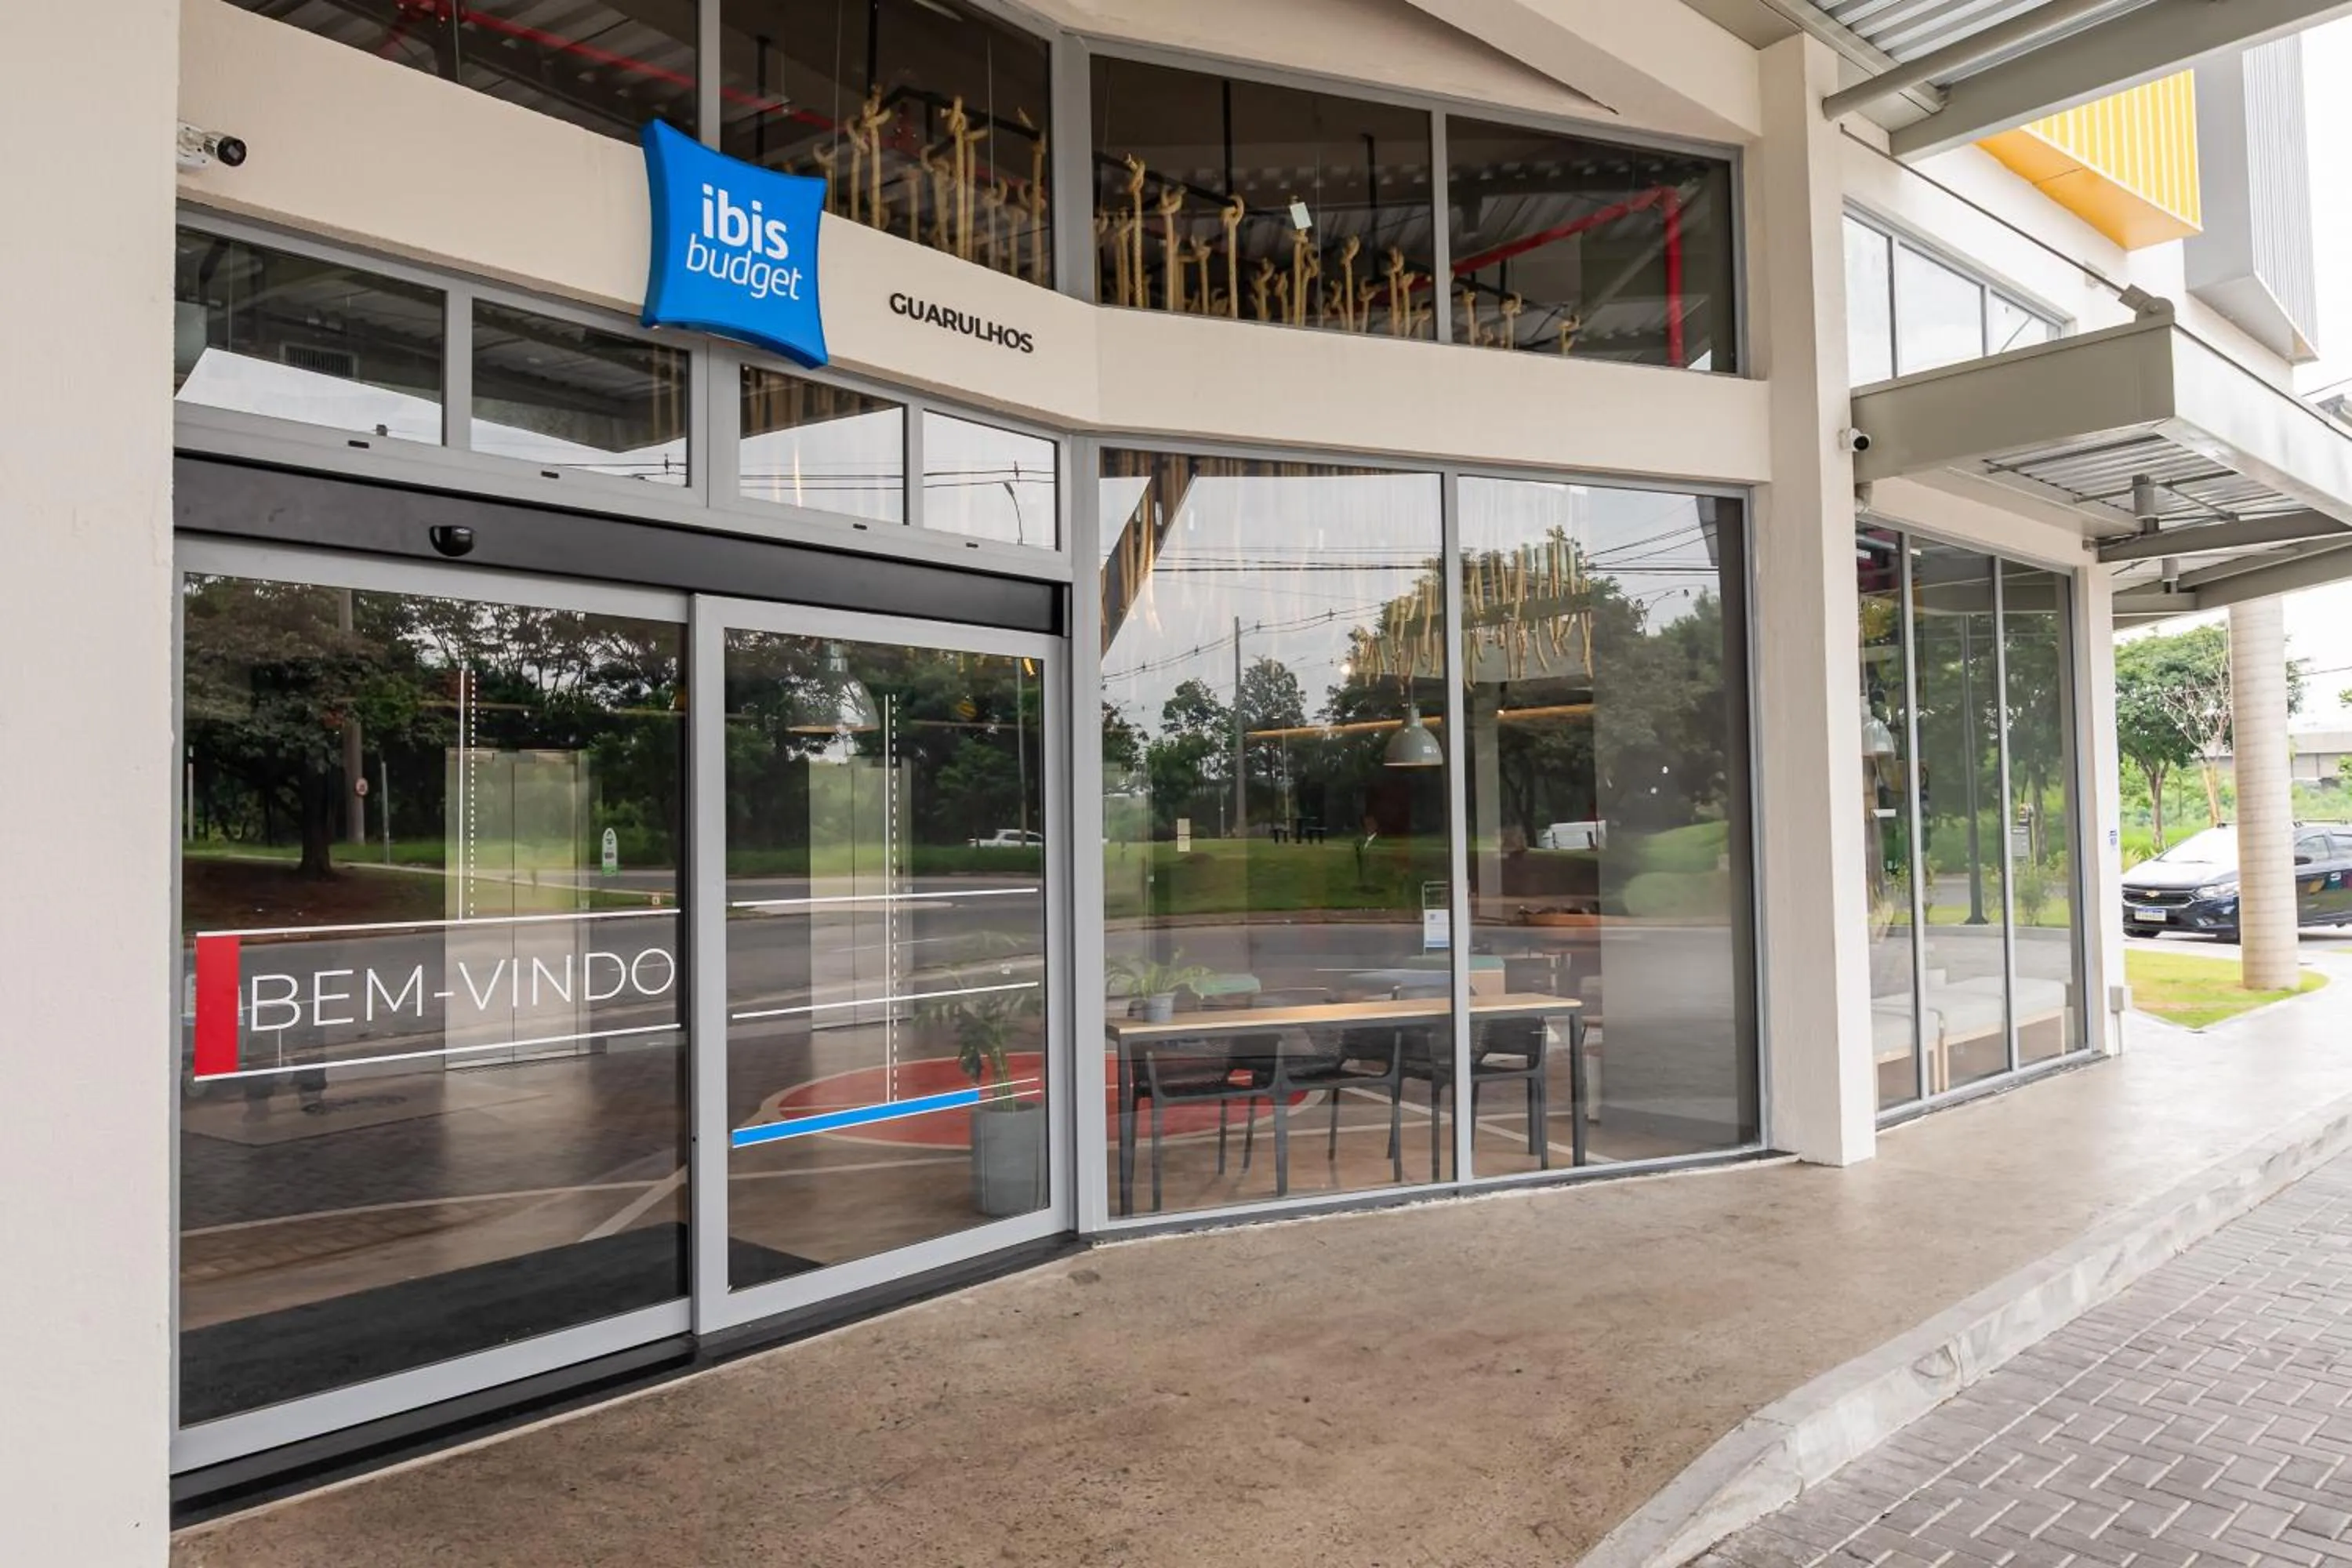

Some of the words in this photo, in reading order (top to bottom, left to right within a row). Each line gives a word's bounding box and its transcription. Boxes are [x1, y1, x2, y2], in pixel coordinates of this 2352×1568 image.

[702, 183, 789, 260] ibis
[686, 233, 803, 300] budget
[889, 292, 1034, 354] GUARULHOS
[250, 947, 676, 1033] BEM-VINDO
